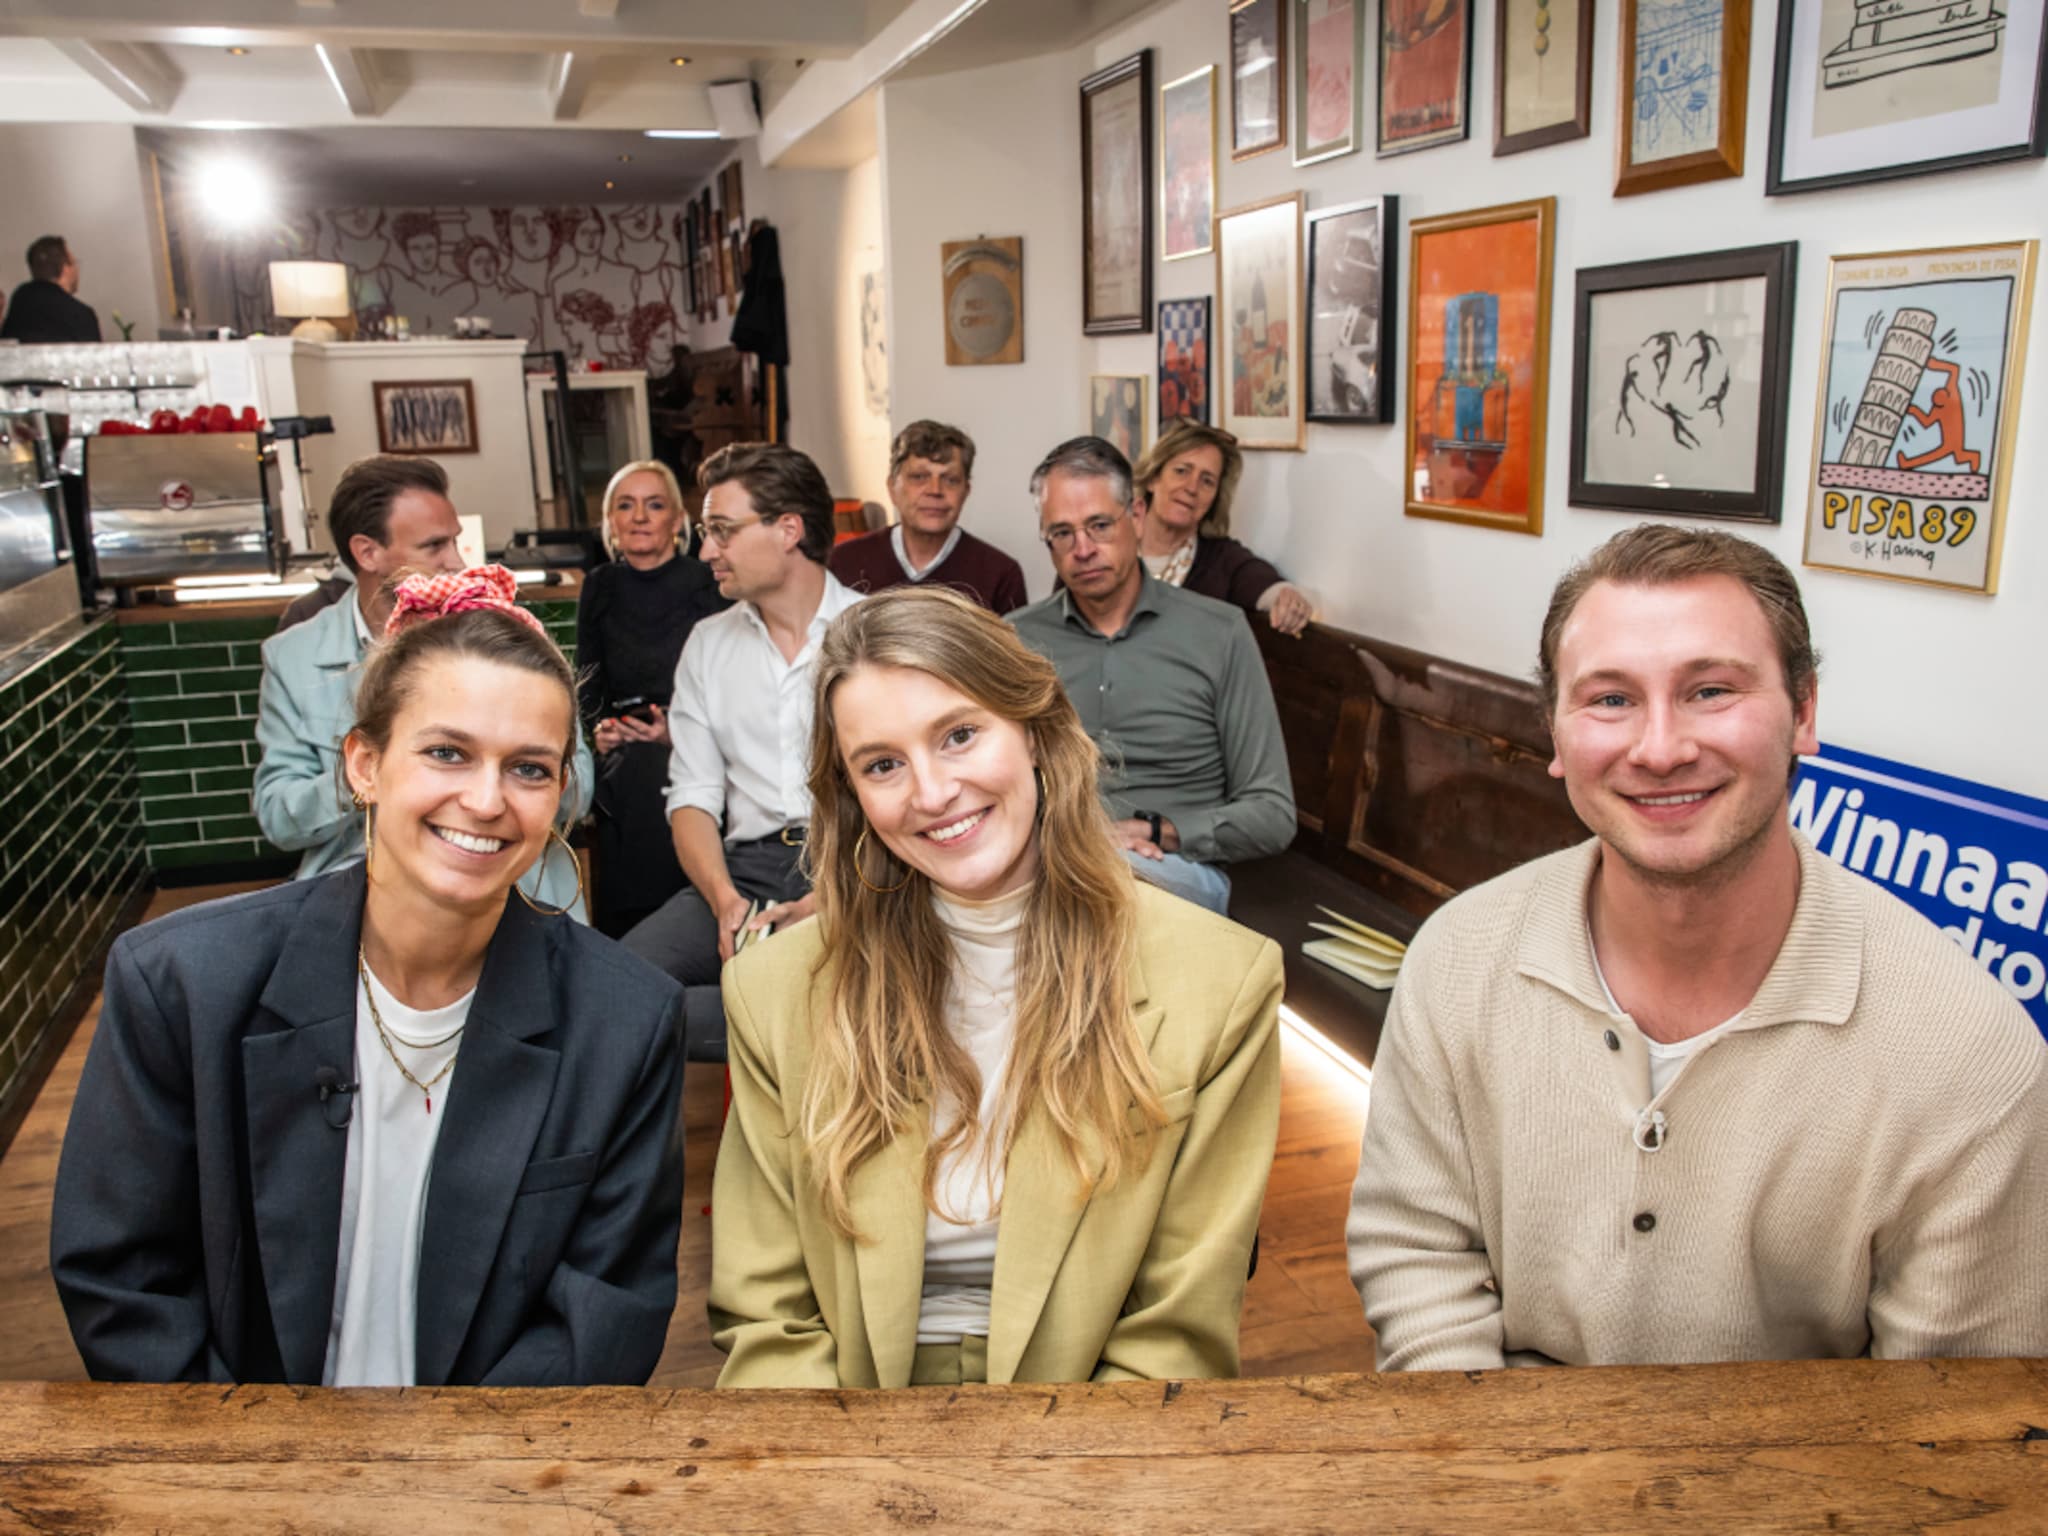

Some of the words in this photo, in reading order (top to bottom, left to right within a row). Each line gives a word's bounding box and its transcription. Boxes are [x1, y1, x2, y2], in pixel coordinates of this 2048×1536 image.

[1823, 491, 1915, 539] PISA
[1919, 504, 1977, 547] 89
[1789, 777, 2048, 935] Winnaa
